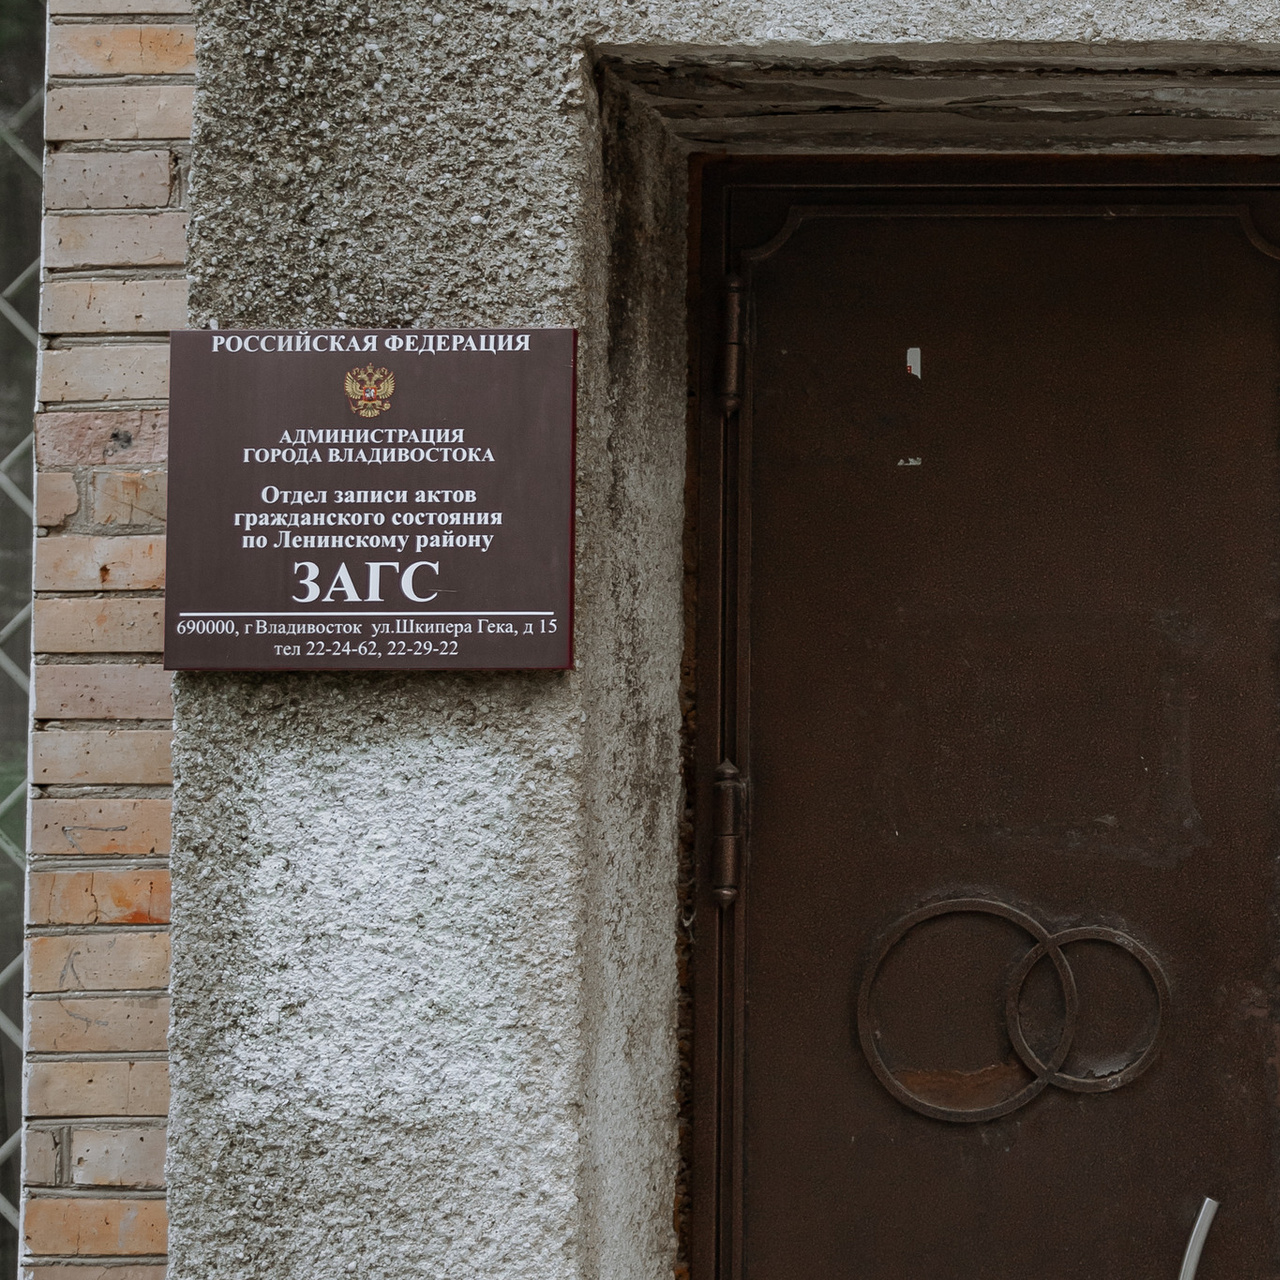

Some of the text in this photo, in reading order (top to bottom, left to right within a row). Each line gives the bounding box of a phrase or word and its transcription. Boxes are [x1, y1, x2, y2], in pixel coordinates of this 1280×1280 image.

[212, 332, 531, 355] РОССИЙСКАЯ ФЕДЕРАЦИЯ
[279, 428, 465, 446] АДМИНИСТРАЦИЯ
[243, 447, 496, 465] ГОРОДА ВЛАДИВОСТОКА
[261, 486, 477, 506] Отдел записи актов
[233, 510, 503, 531] гражданского состояния
[242, 530, 494, 552] по Ленинскому району
[292, 560, 440, 603] ЗАГС
[176, 621, 240, 637] 690000,
[256, 620, 362, 637] Владивосток
[477, 620, 519, 636] Гека,
[523, 623, 534, 636] д
[539, 619, 558, 634] 15
[274, 641, 459, 659] тел 22-24-62, 22-29-22
